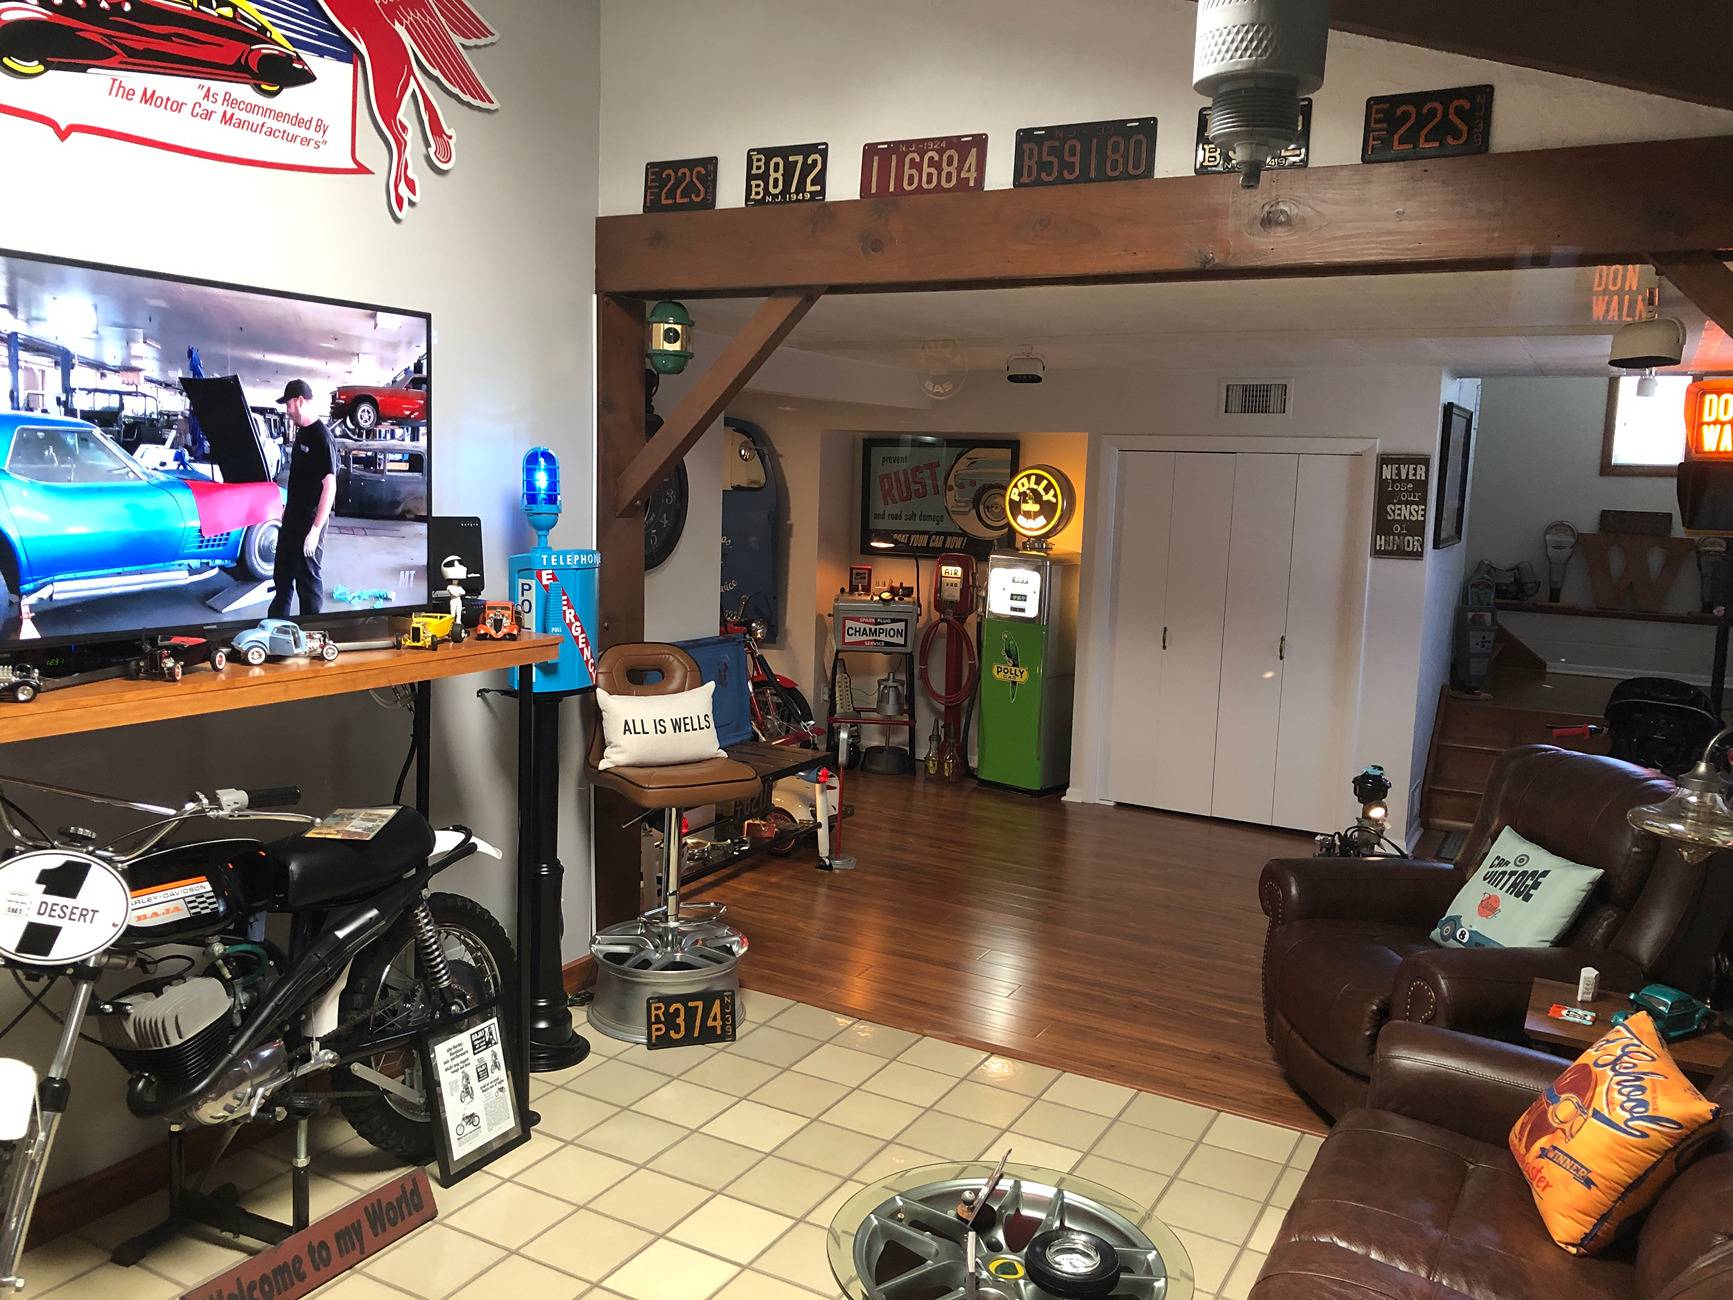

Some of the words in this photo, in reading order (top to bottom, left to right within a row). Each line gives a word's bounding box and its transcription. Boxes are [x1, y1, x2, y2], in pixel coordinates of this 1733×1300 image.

[108, 77, 136, 101] The
[139, 87, 188, 114] Motor
[190, 101, 217, 122] Car
[219, 110, 328, 150] Manufacturers"
[197, 84, 218, 104] "As
[221, 91, 313, 131] Recommended
[314, 118, 330, 138] By
[1391, 98, 1472, 151] 22S
[870, 146, 978, 194] 116684
[1020, 133, 1148, 183] B59180
[660, 166, 706, 205] 22S
[768, 153, 822, 194] 872
[1702, 393, 1733, 422] DO
[1702, 424, 1733, 452] WA
[881, 455, 908, 466] prevent
[1382, 464, 1426, 480] NEVER
[879, 460, 940, 506] RUST
[1010, 475, 1057, 503] POLLY
[1388, 480, 1414, 491] lose
[1394, 491, 1422, 503] your
[873, 510, 886, 520] and
[887, 510, 903, 521] road
[918, 510, 945, 526] damage
[1386, 504, 1426, 521] SENSE
[909, 534, 929, 547] YOUR
[929, 535, 944, 548] CAR
[944, 536, 968, 549] NOW!
[1376, 535, 1423, 552] HUMOR
[541, 569, 598, 685] EERGENCY
[846, 626, 904, 639] CHAMPION
[996, 666, 1025, 679] POLLY
[623, 719, 650, 736] ALL
[653, 718, 667, 735] IS
[670, 713, 711, 734] WELLS
[1482, 869, 1552, 903] VINTAGE
[37, 900, 100, 925] DESERT
[1458, 929, 1466, 941] 8
[669, 998, 722, 1040] 374
[306, 1239, 332, 1273] to
[334, 1218, 366, 1256] my
[363, 1175, 425, 1237] World
